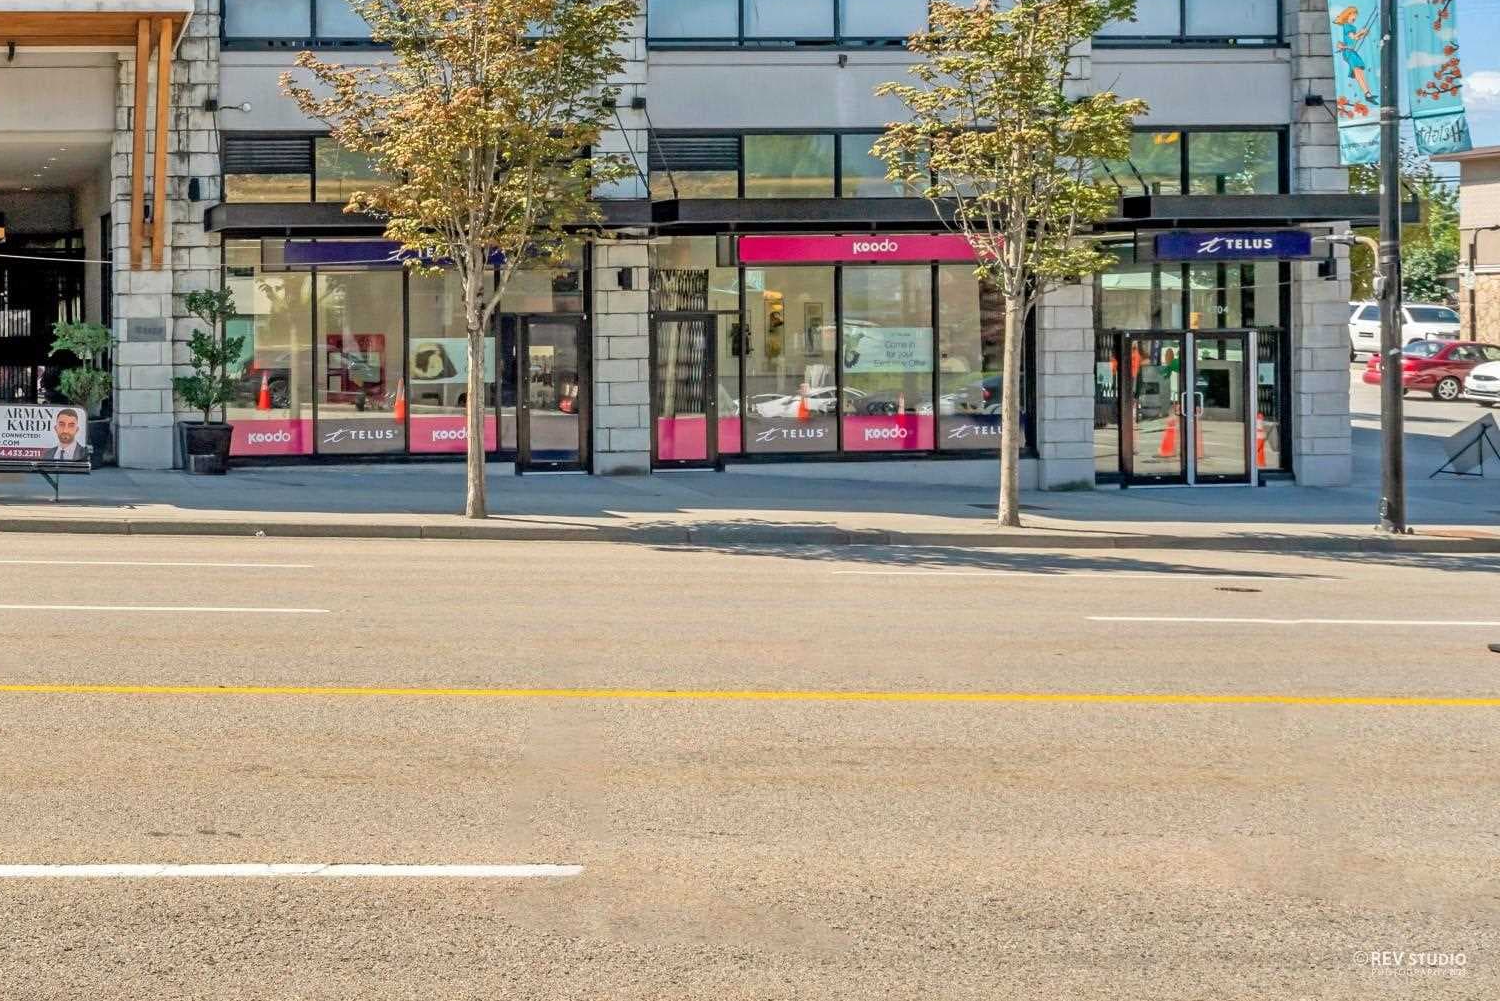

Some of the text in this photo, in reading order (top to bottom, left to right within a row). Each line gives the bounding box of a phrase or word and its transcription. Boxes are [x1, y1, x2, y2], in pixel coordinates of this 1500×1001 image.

[853, 239, 898, 255] koodo
[1225, 238, 1274, 249] TELUS
[6, 408, 54, 419] ARMAN
[7, 420, 51, 431] KARDI
[974, 425, 1003, 435] TELU
[248, 430, 291, 444] koodo
[350, 429, 393, 440] TELUS
[432, 427, 468, 442] kood
[782, 428, 824, 438] TELUS
[865, 427, 908, 441] koodo
